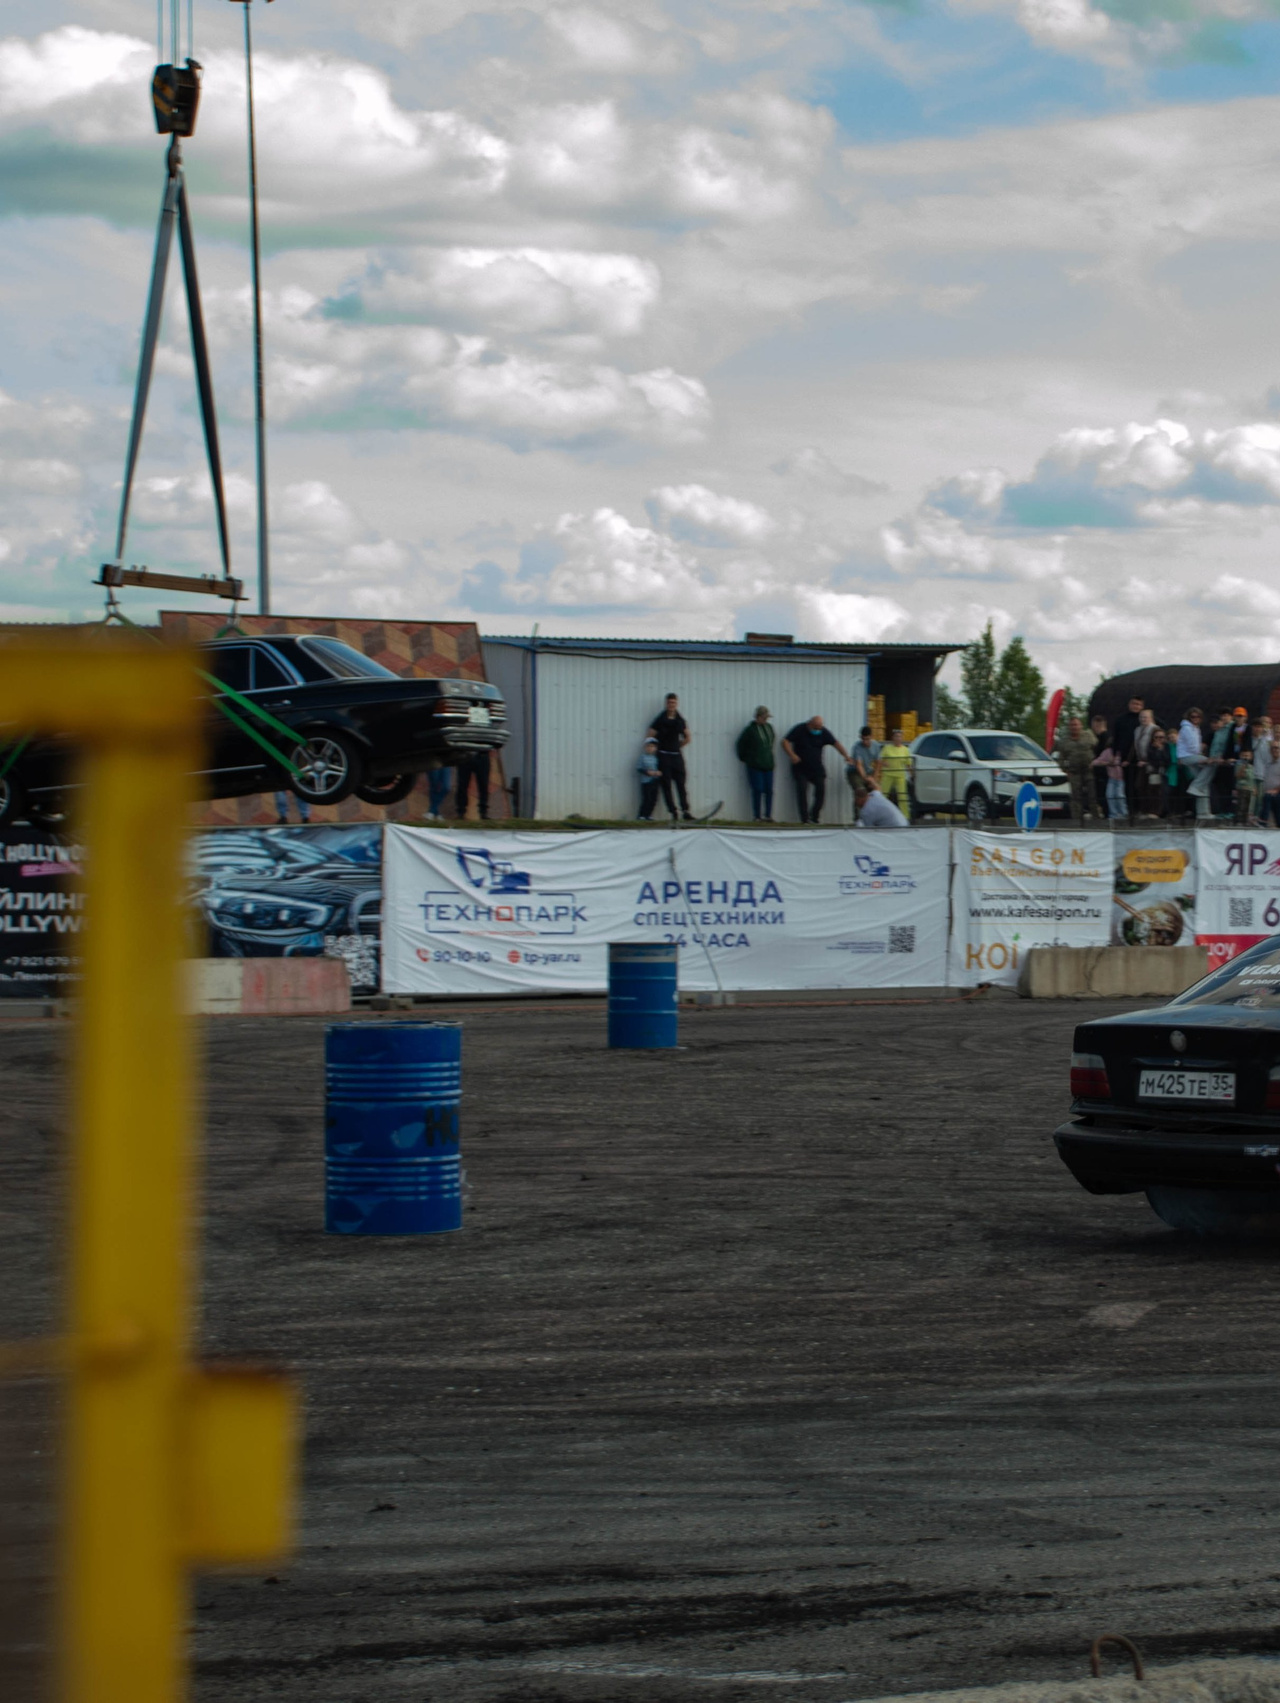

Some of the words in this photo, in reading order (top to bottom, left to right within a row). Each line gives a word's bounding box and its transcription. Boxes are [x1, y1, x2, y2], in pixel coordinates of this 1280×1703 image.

[6, 843, 90, 862] HOLLYWO
[970, 846, 1085, 865] SAIGON
[1225, 843, 1268, 876] ЯР
[636, 880, 783, 907] АРЕНДА
[418, 904, 588, 922] ТЕХНОПАРК
[633, 911, 785, 927] СПЕЦТЕХНИКИ
[969, 906, 1100, 920] www.kafesaigon.ru
[0, 914, 90, 932] LLYW
[692, 933, 751, 947] ЧАСА
[524, 951, 581, 965] tp-yar.ru
[1212, 1075, 1229, 1091] 35
